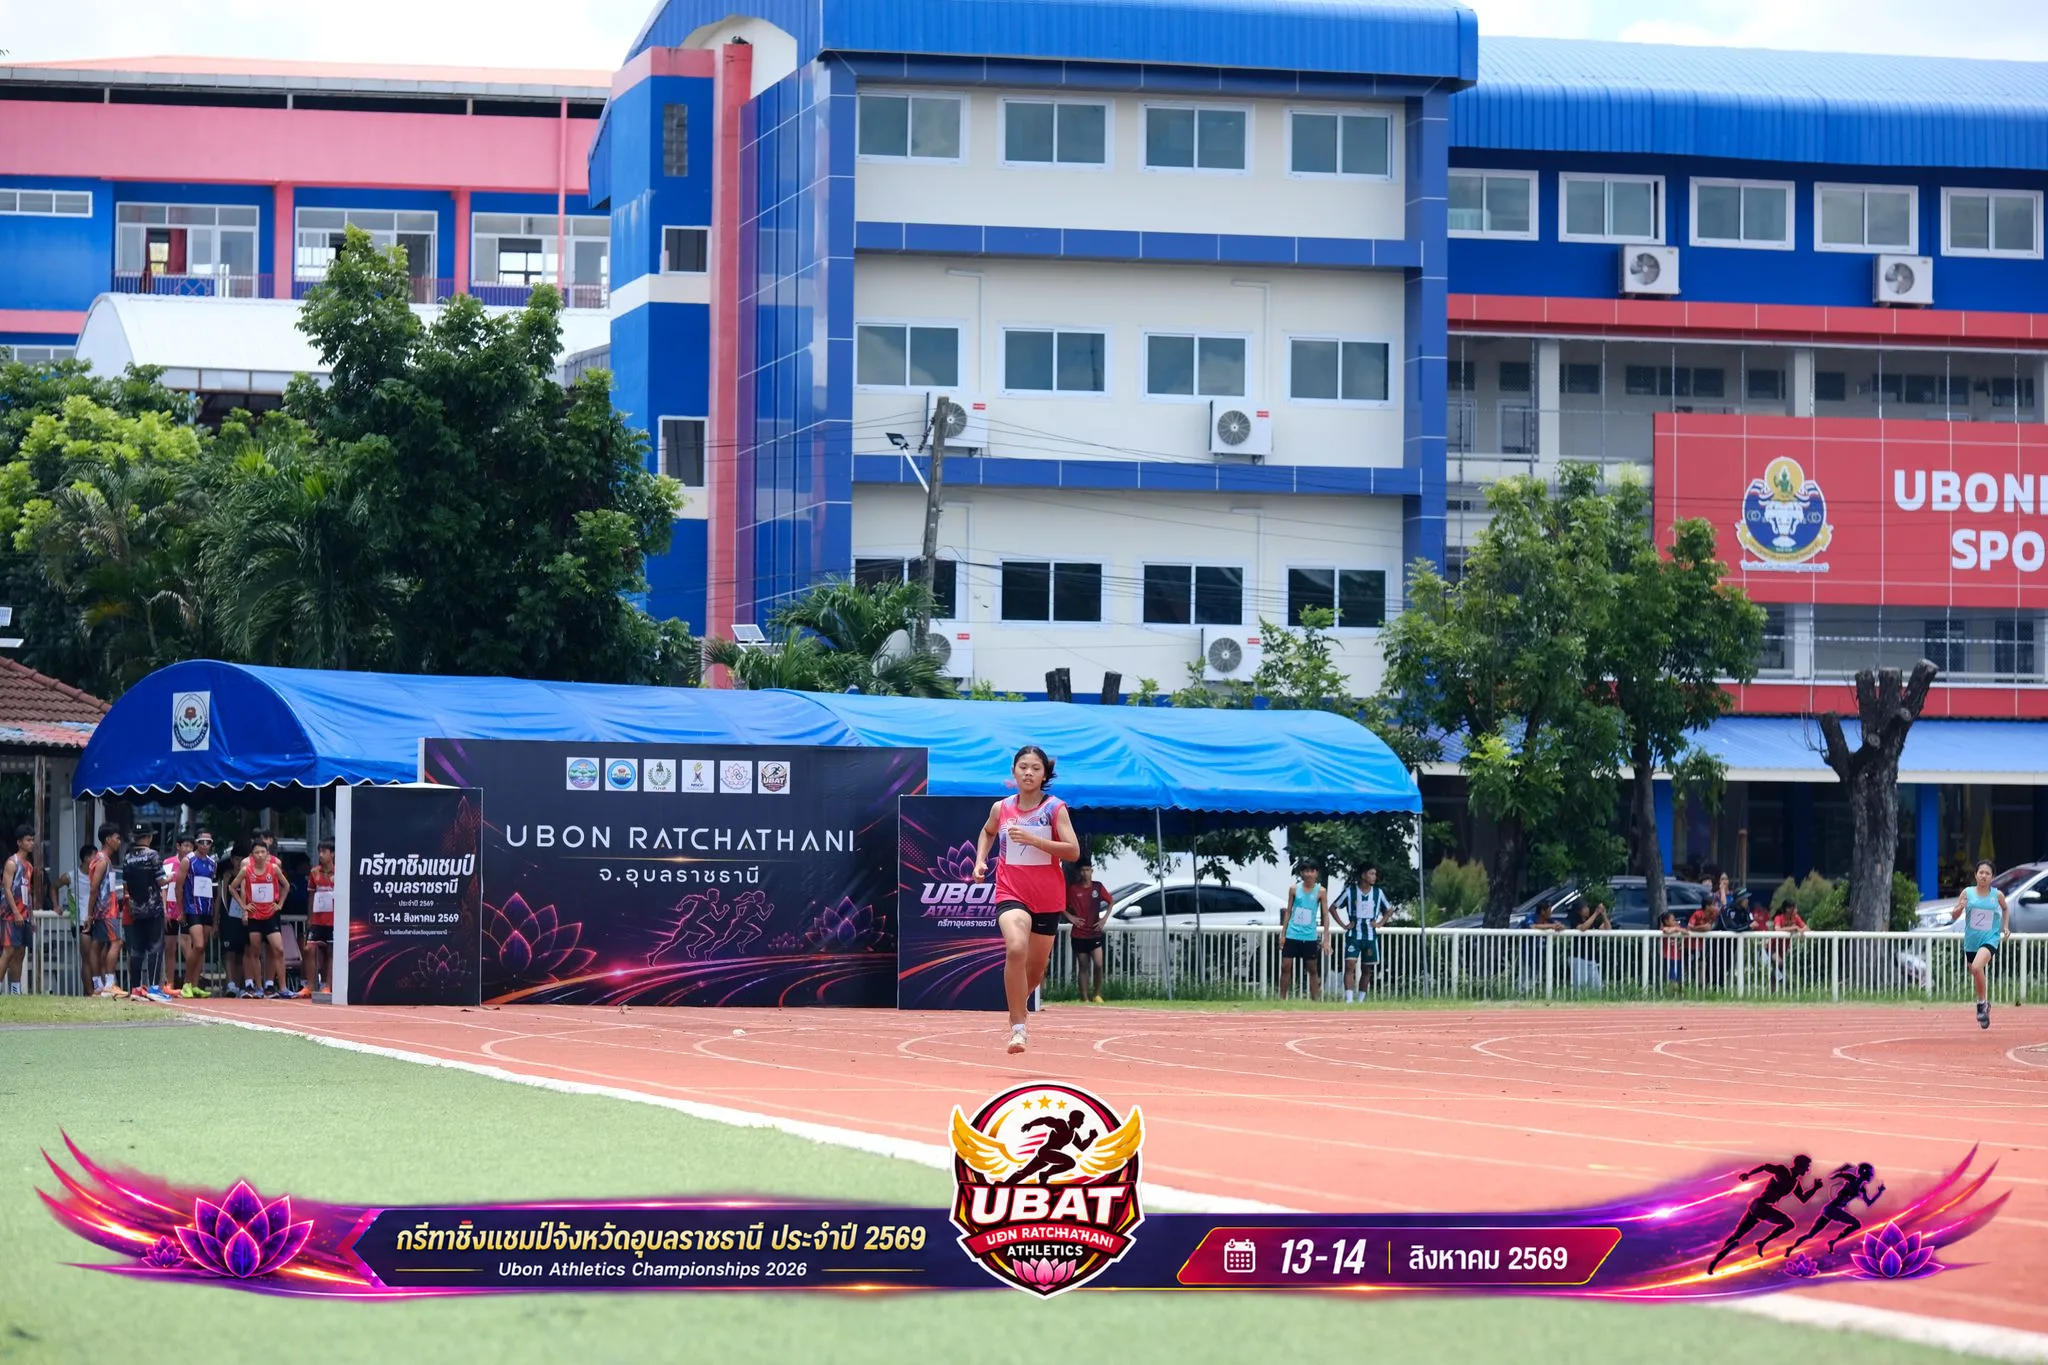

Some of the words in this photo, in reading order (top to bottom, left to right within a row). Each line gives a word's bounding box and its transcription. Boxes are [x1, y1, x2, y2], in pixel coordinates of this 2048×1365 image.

[1894, 469, 2048, 515] UBON
[506, 825, 610, 848] UBON
[629, 827, 854, 851] RATCHATHANI
[600, 865, 759, 888] จ.อุบลราชธานี
[258, 886, 267, 901] 5
[373, 878, 459, 898] จ.อุบลราชธานี
[403, 912, 436, 923] สิงหาคม
[438, 913, 459, 923] 2569
[1975, 912, 1986, 927] 2
